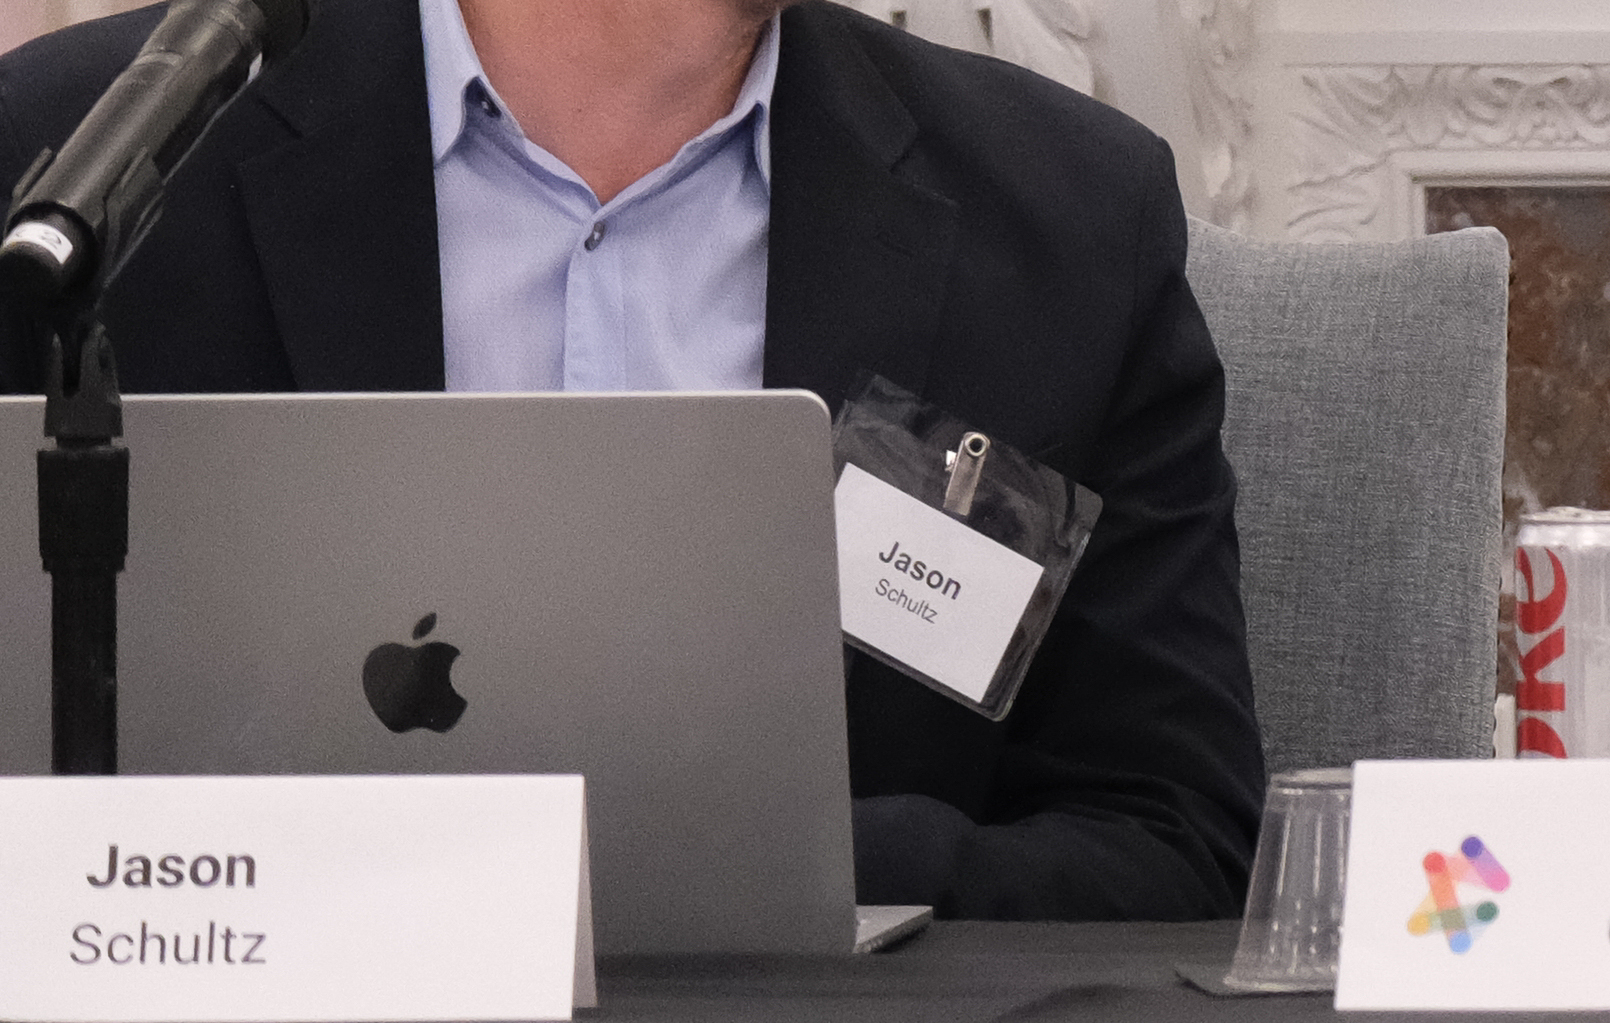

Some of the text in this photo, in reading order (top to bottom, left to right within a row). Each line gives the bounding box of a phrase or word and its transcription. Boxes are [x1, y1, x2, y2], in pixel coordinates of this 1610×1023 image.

[877, 540, 963, 601] Jason
[874, 577, 939, 625] Schultz
[86, 843, 257, 889] Jason
[69, 920, 267, 966] Schultz
